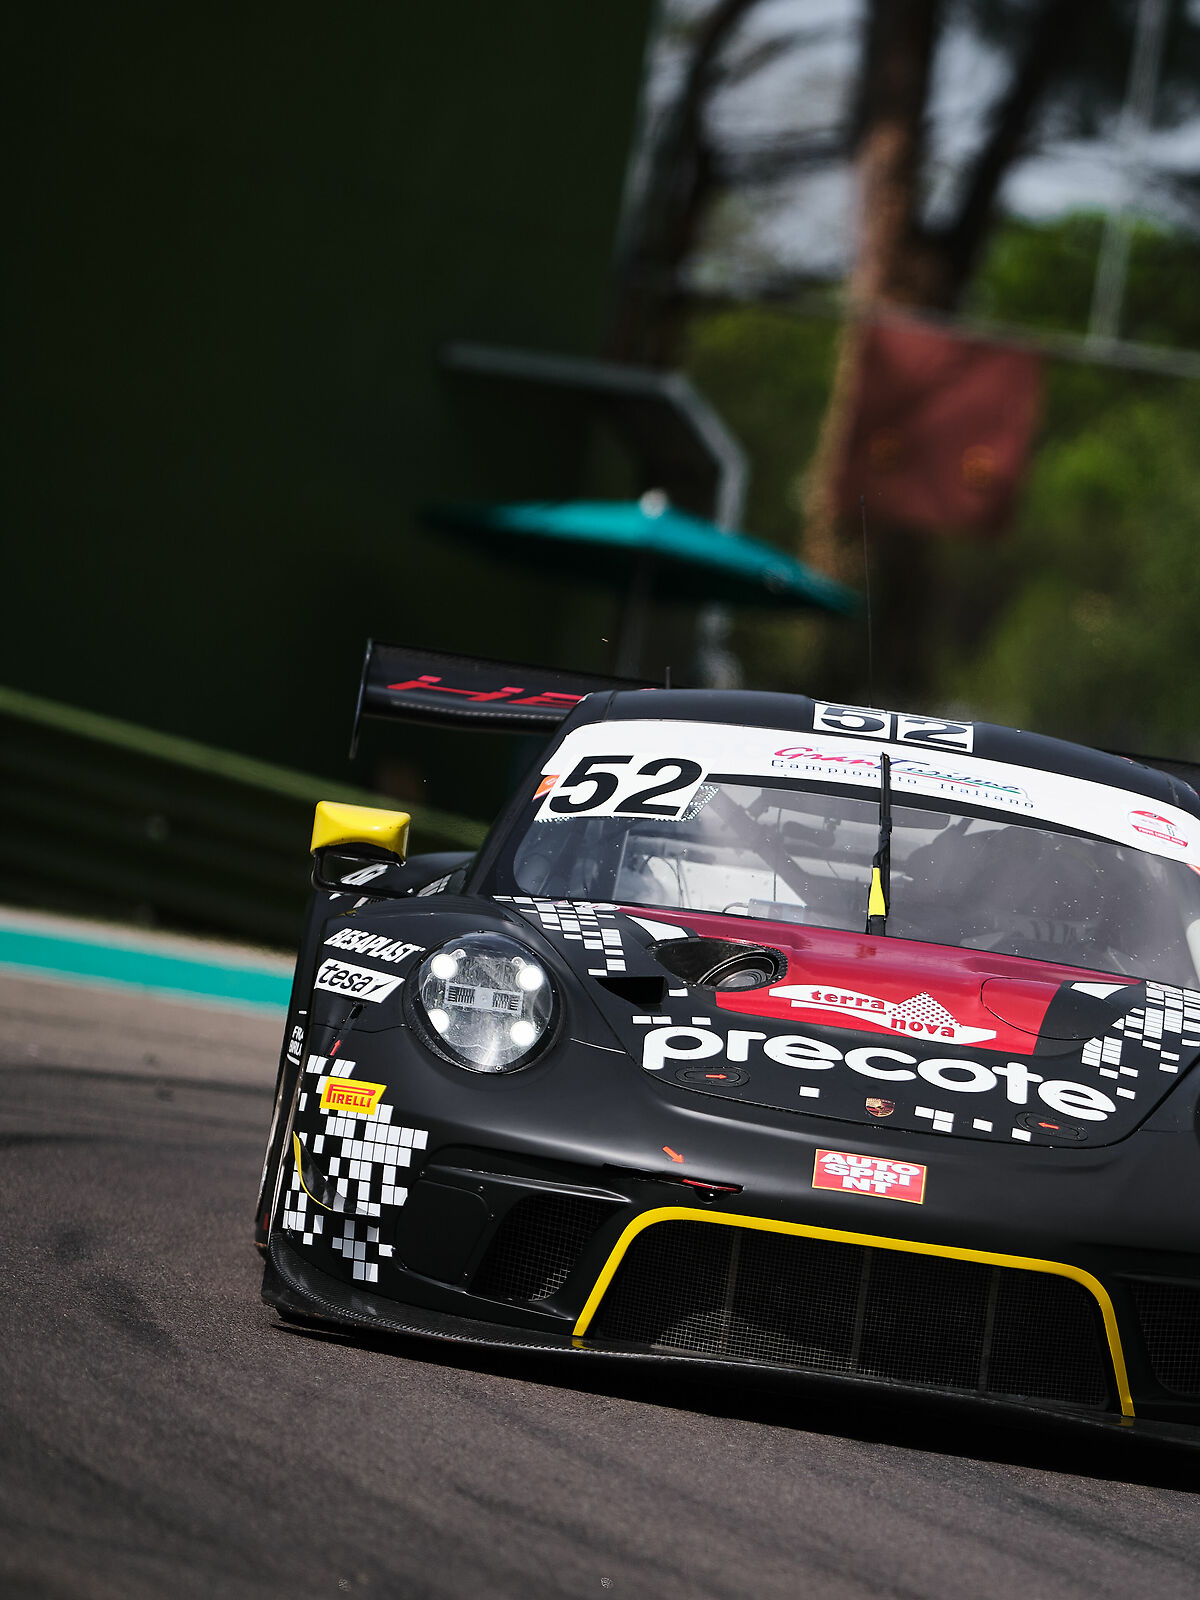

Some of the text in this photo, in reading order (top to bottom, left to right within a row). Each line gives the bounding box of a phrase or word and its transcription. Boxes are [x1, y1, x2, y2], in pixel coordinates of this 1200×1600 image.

[821, 706, 968, 749] 52
[548, 755, 703, 816] 52
[771, 759, 1034, 809] Campionto Italiano
[324, 928, 420, 964] BESAPLAST
[318, 963, 374, 993] tesa
[810, 989, 886, 1010] terra
[890, 1017, 956, 1038] nova
[642, 1025, 1117, 1121] precote
[326, 1083, 377, 1108] PIRELLI
[819, 1152, 921, 1176] AUTO
[823, 1162, 911, 1187] SPRI
[841, 1175, 893, 1195] NT
